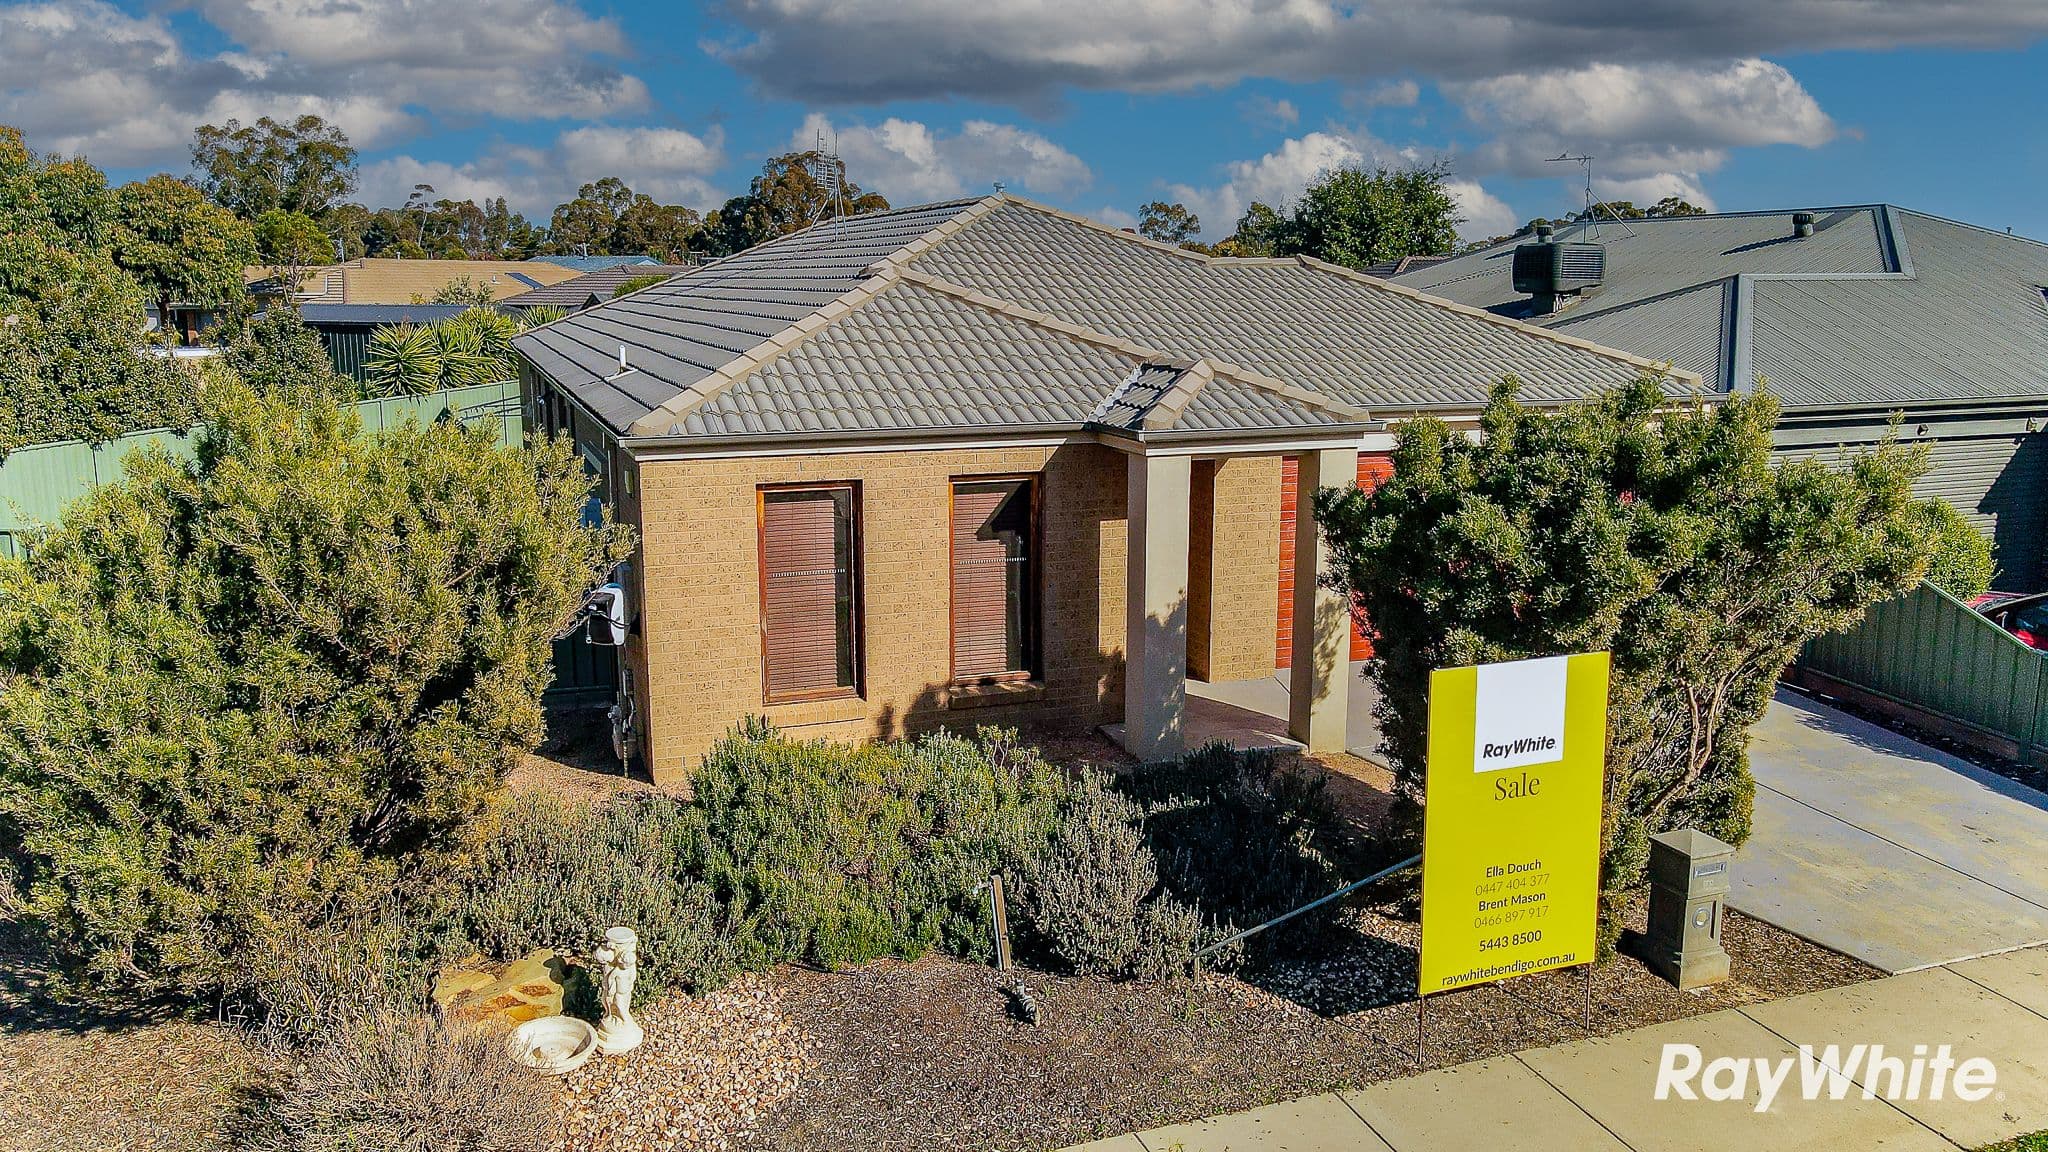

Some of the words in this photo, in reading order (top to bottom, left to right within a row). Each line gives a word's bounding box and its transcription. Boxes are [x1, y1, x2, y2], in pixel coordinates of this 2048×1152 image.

[1482, 736, 1556, 759] RayWhite
[1494, 773, 1540, 801] Sale
[1486, 865, 1504, 878] Ella
[1507, 859, 1541, 875] Douch
[1475, 881, 1503, 896] 0447
[1506, 877, 1526, 890] 404
[1530, 873, 1550, 887] 377
[1478, 899, 1508, 912] Brent
[1511, 891, 1546, 905] Mason
[1474, 912, 1502, 929] 0466
[1505, 909, 1526, 923] 897
[1528, 905, 1549, 918] 917
[1479, 935, 1509, 952] 5443
[1512, 930, 1542, 946] 8500
[1442, 951, 1576, 986] raywhitebendigo.com.au
